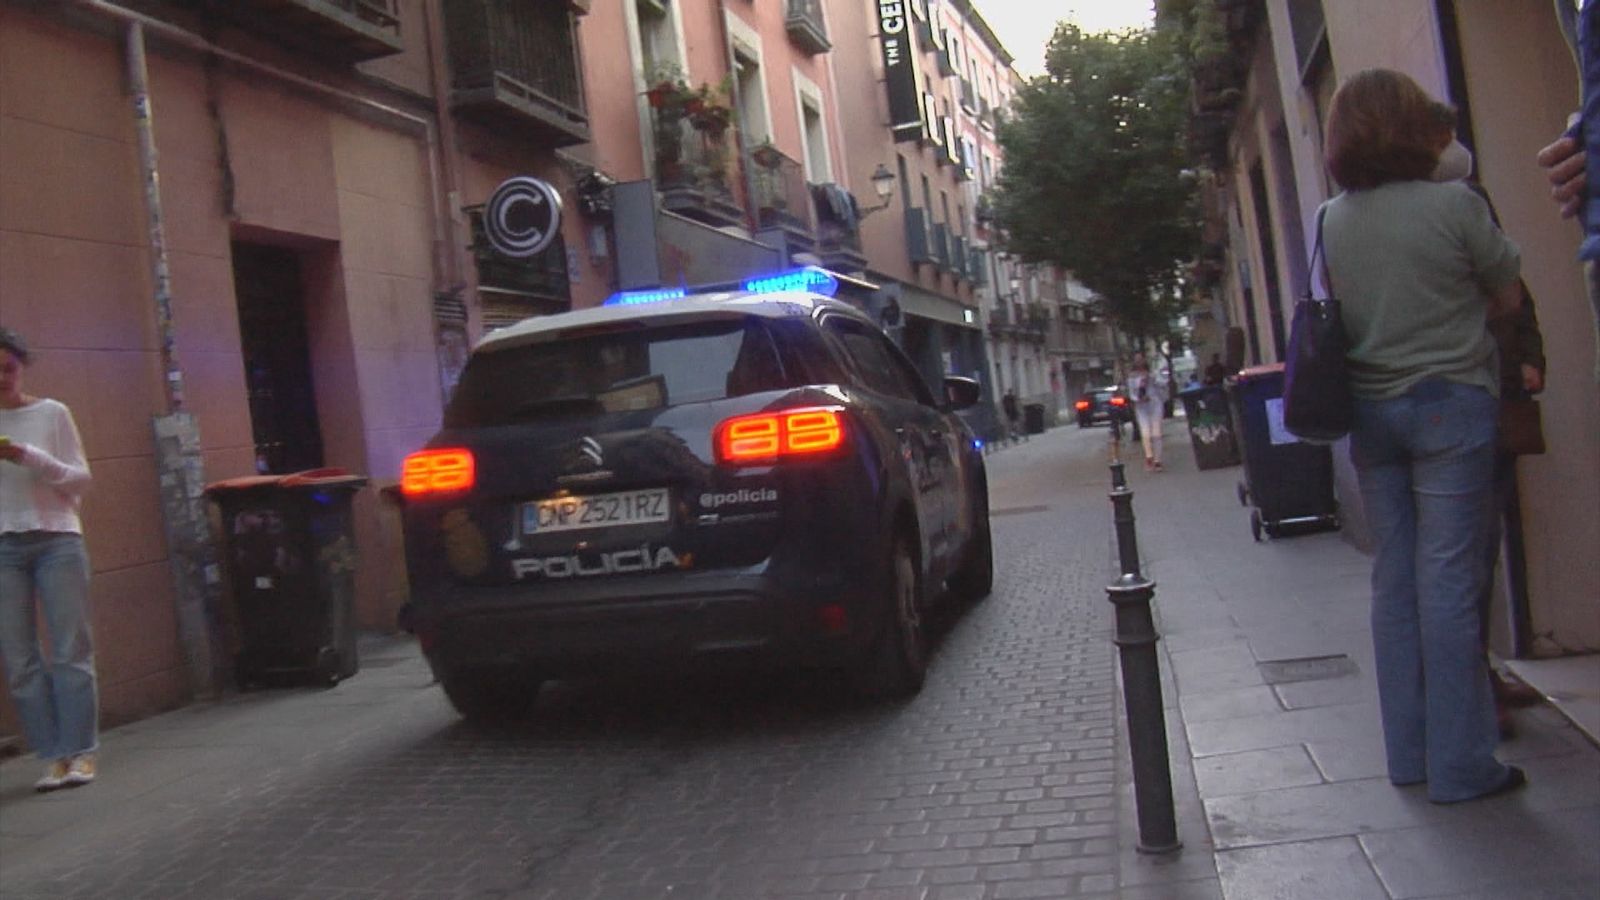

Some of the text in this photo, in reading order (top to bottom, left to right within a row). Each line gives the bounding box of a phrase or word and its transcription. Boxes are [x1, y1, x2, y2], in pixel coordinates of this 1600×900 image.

[885, 39, 900, 66] THE
[491, 185, 543, 248] C
[699, 488, 777, 508] @policia
[512, 544, 679, 579] POLICÍA
